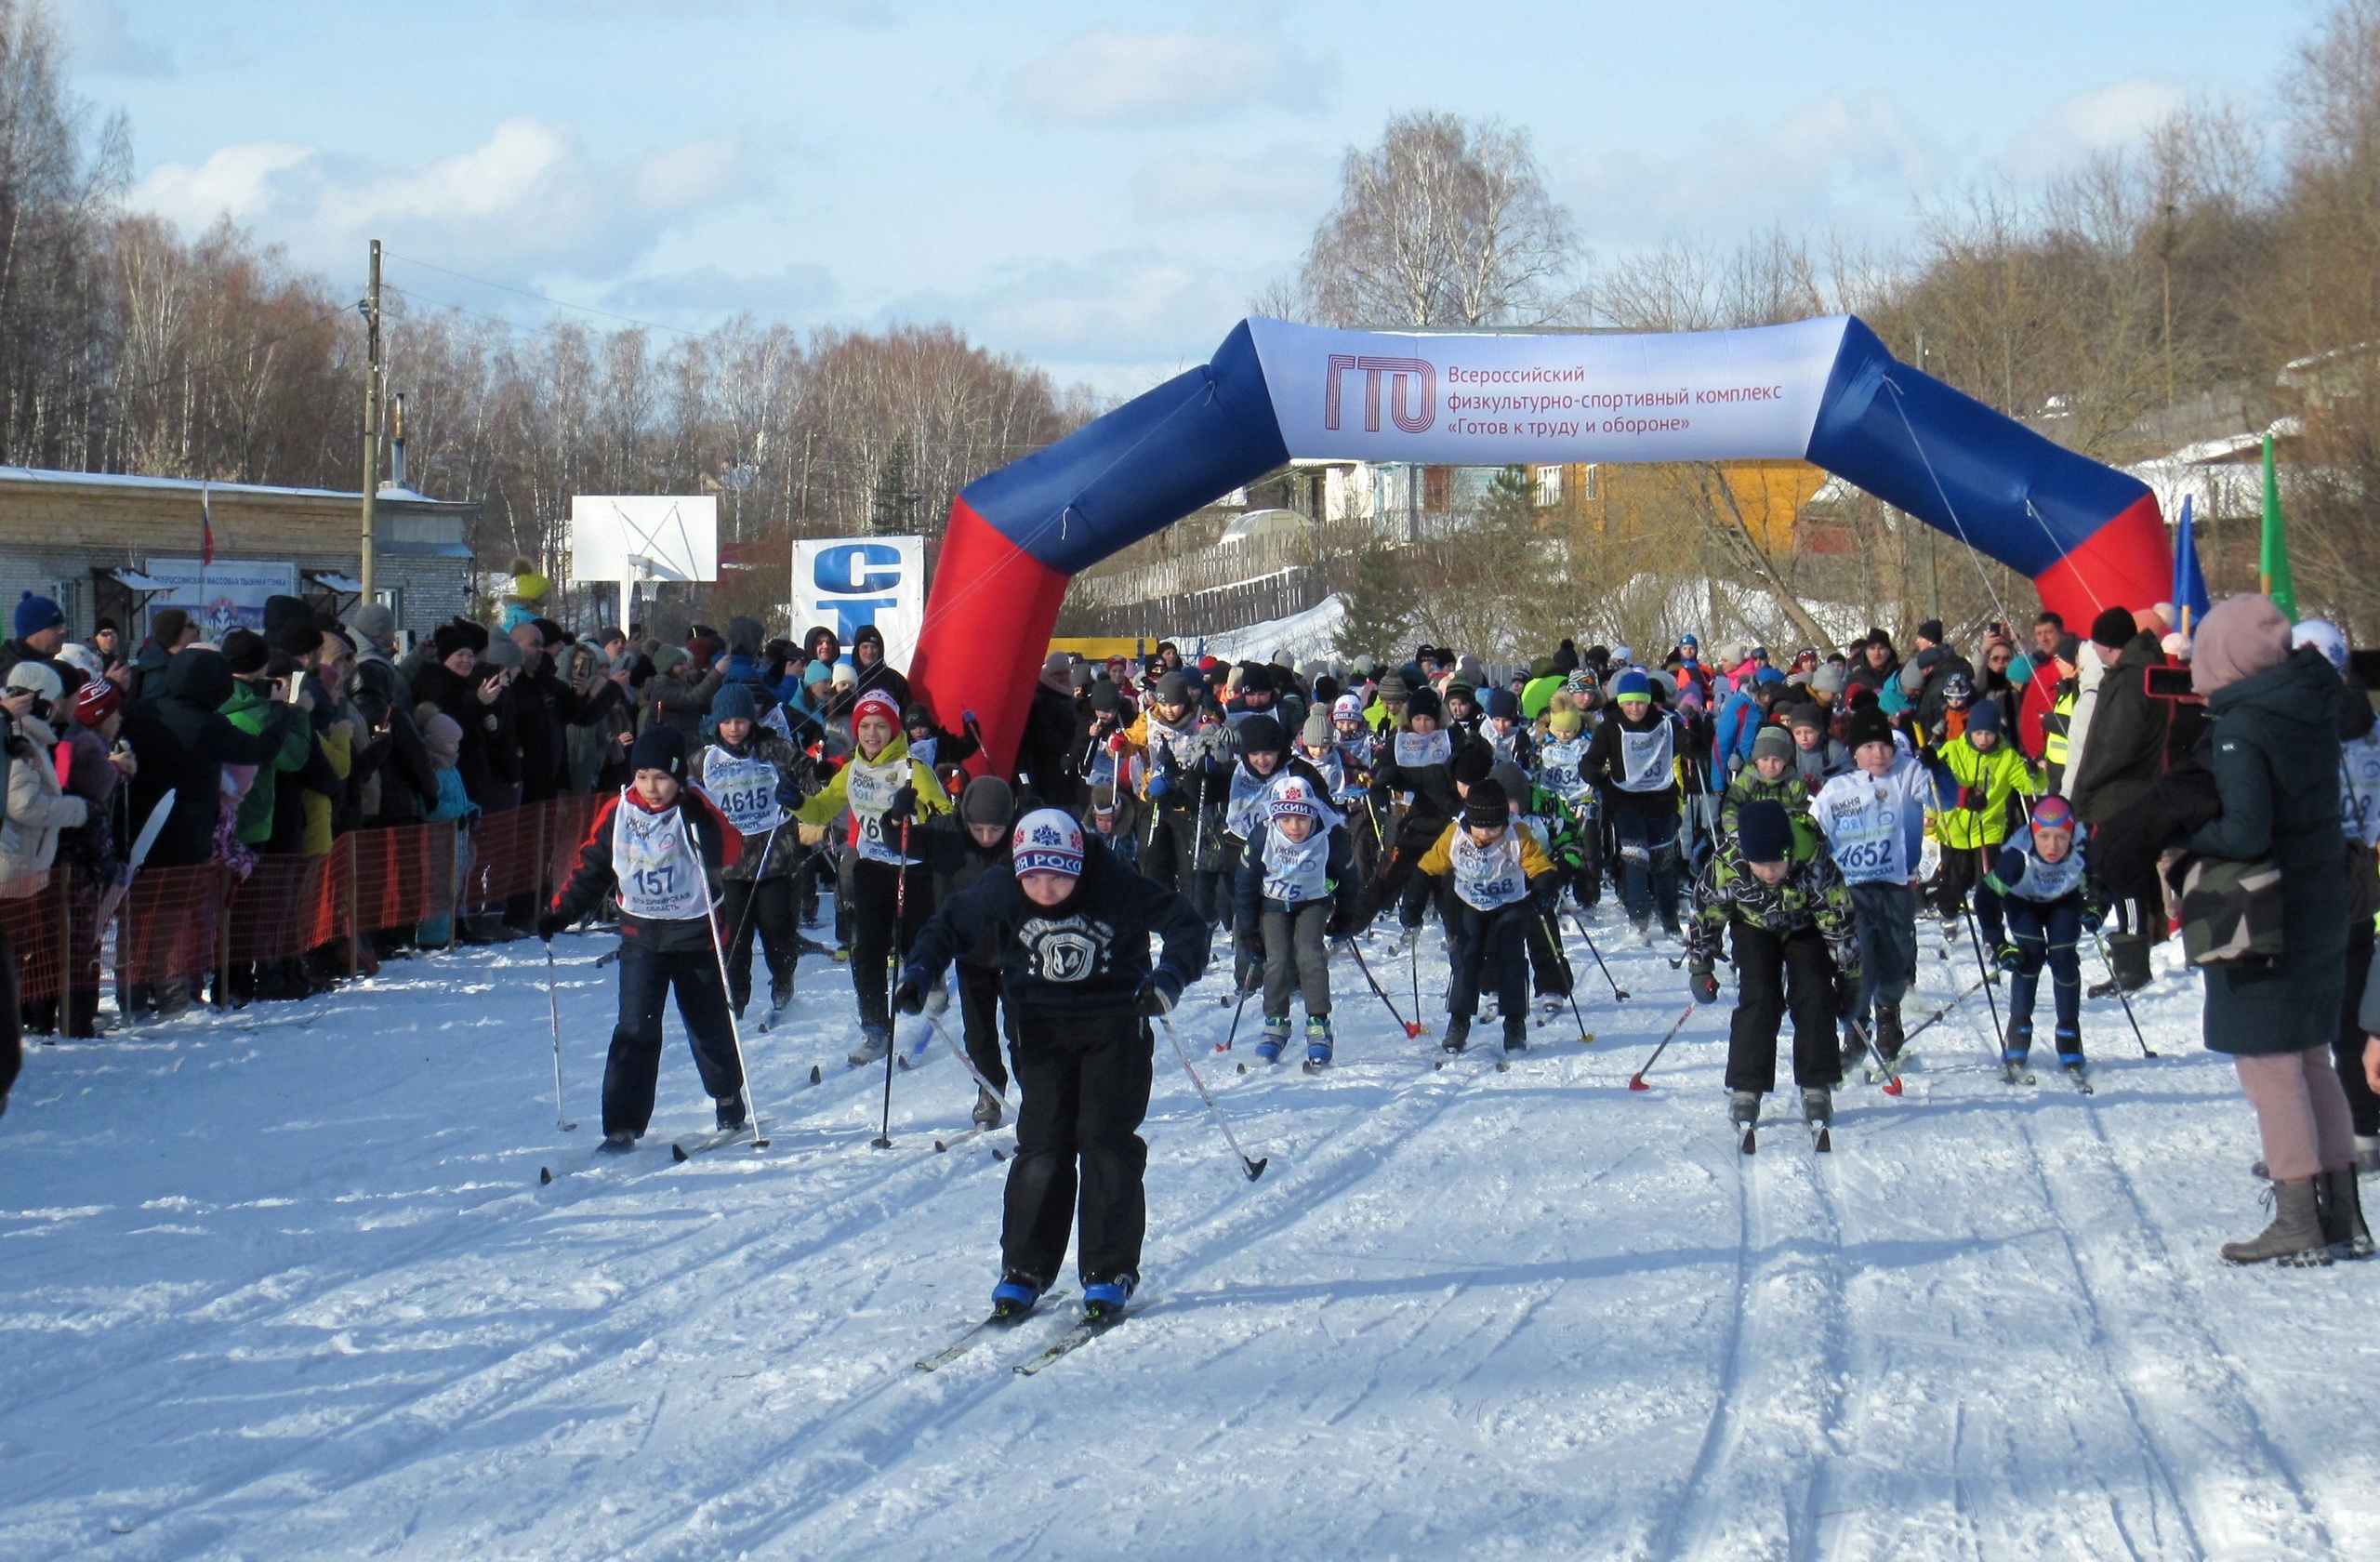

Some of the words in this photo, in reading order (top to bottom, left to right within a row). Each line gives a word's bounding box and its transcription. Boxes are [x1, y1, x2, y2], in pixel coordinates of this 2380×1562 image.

[1448, 365, 1585, 387] Всероссийский
[1325, 354, 1436, 433] ГТО
[1448, 388, 1689, 413] физкультурно-спортивный
[1696, 385, 1782, 404] комплекс
[1448, 417, 1508, 434] «Готов
[1514, 422, 1525, 434] к
[1527, 421, 1580, 438] труду
[1585, 422, 1596, 433] и
[1603, 417, 1690, 435] обороне»
[1546, 767, 1580, 786] 4634
[721, 787, 768, 814] 4615
[1836, 840, 1893, 868] 4652
[632, 866, 673, 895] 157
